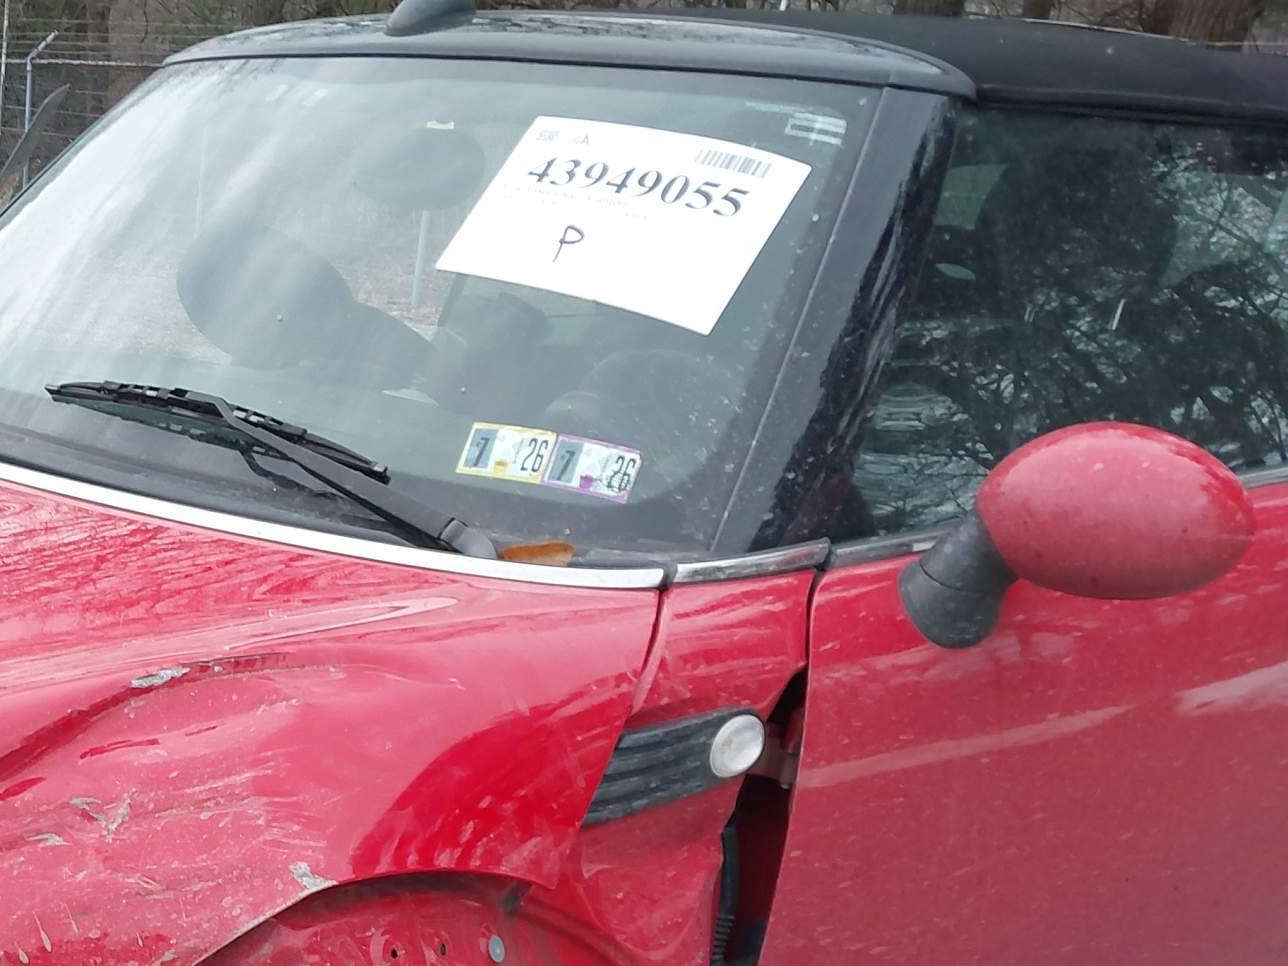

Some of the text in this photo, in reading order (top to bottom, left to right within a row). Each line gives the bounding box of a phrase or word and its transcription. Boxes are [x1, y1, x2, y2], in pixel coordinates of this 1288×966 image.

[528, 156, 750, 217] 43949055
[552, 224, 585, 263] P
[473, 436, 549, 474] 7 26
[556, 450, 637, 493] 7 26
